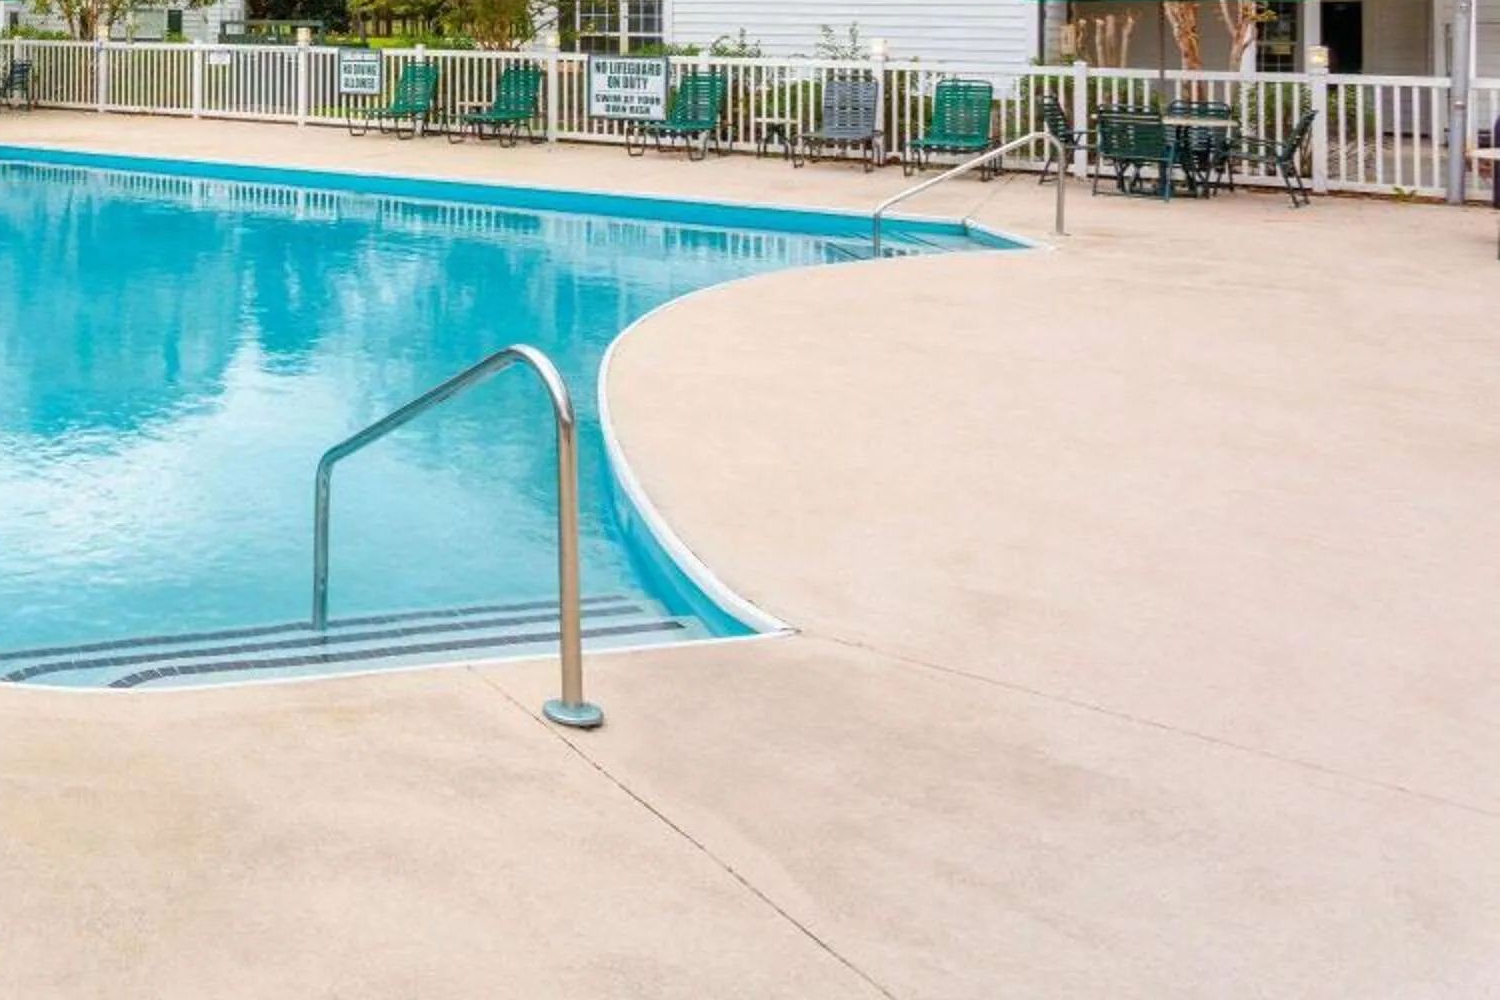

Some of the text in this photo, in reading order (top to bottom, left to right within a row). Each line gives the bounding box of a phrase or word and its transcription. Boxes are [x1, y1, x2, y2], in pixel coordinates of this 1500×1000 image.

[595, 61, 662, 77] NO LIFEGUARD
[607, 75, 649, 90] ON DUTY
